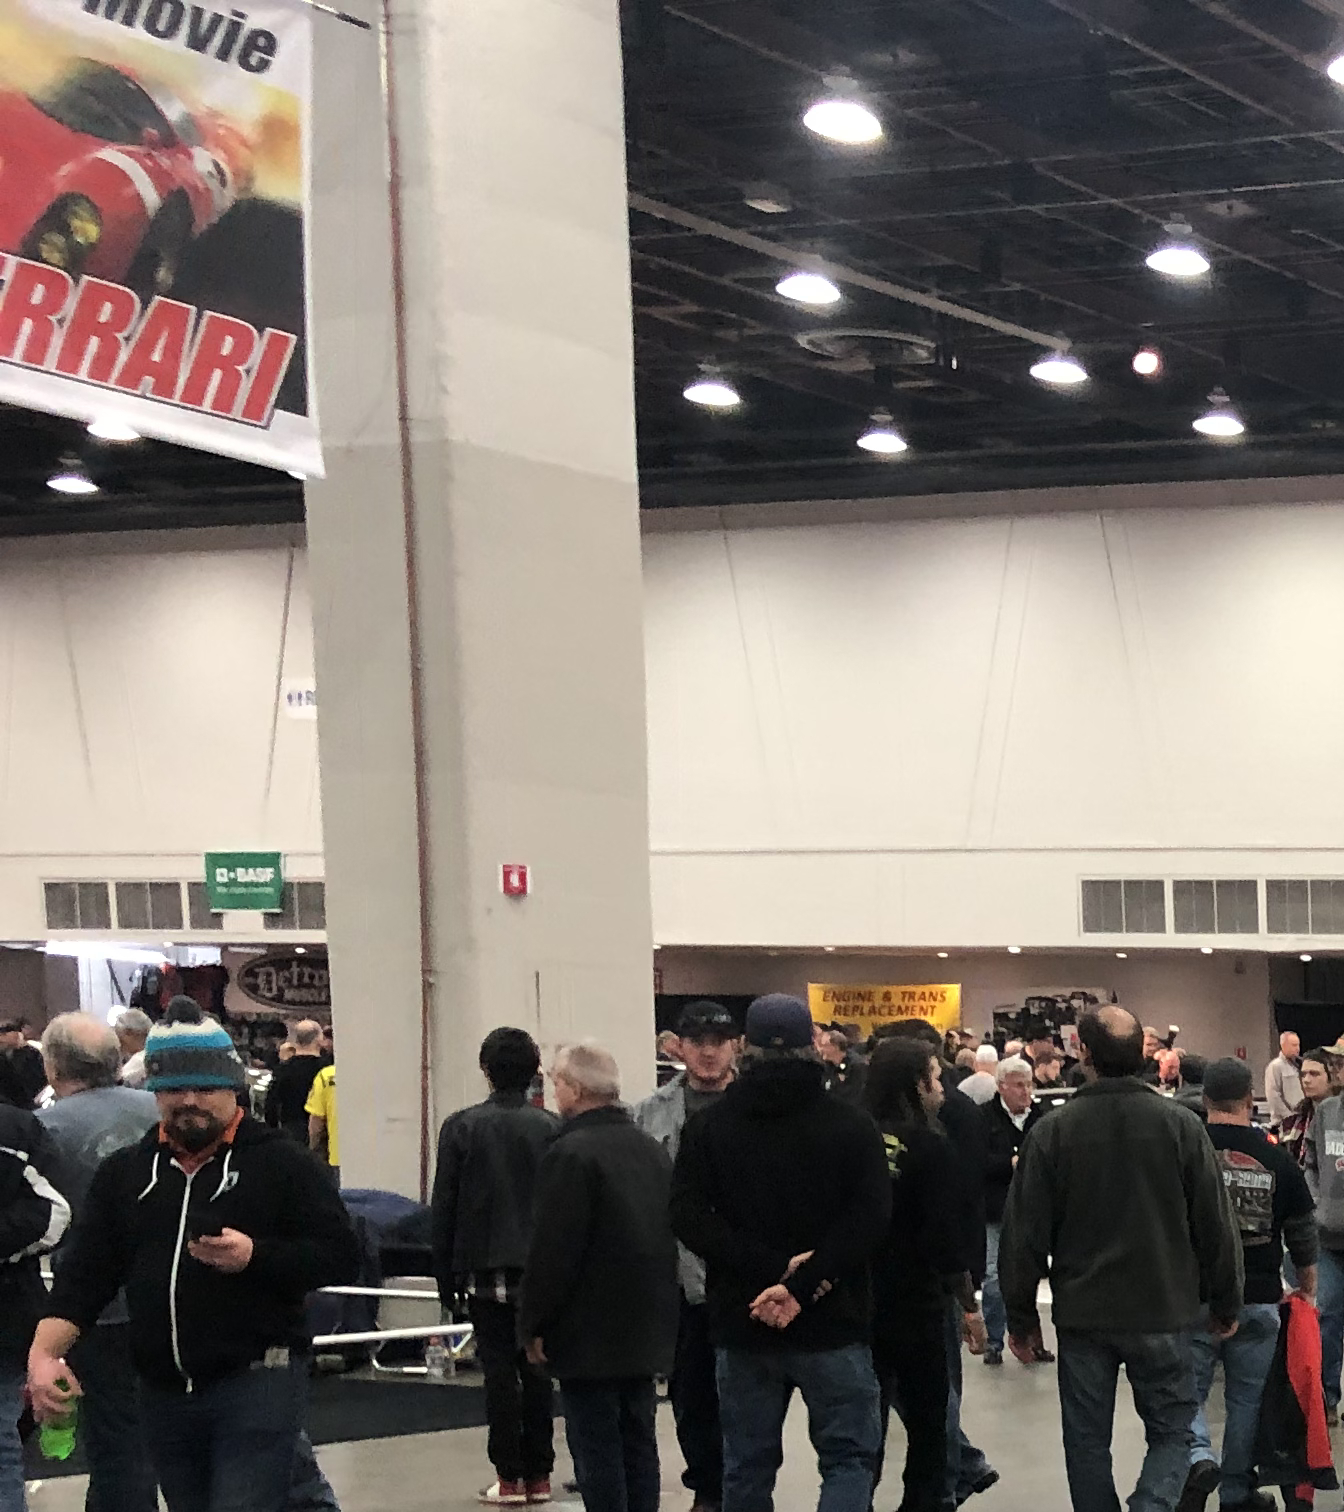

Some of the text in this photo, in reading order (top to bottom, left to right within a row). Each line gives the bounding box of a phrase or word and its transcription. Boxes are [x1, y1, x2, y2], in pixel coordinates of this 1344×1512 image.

[0, 250, 297, 427] RRARI
[236, 867, 275, 882] BASF
[822, 990, 875, 1003] ENGINE
[900, 990, 948, 1003] TRANS
[833, 1004, 938, 1017] REPLACEMENT
